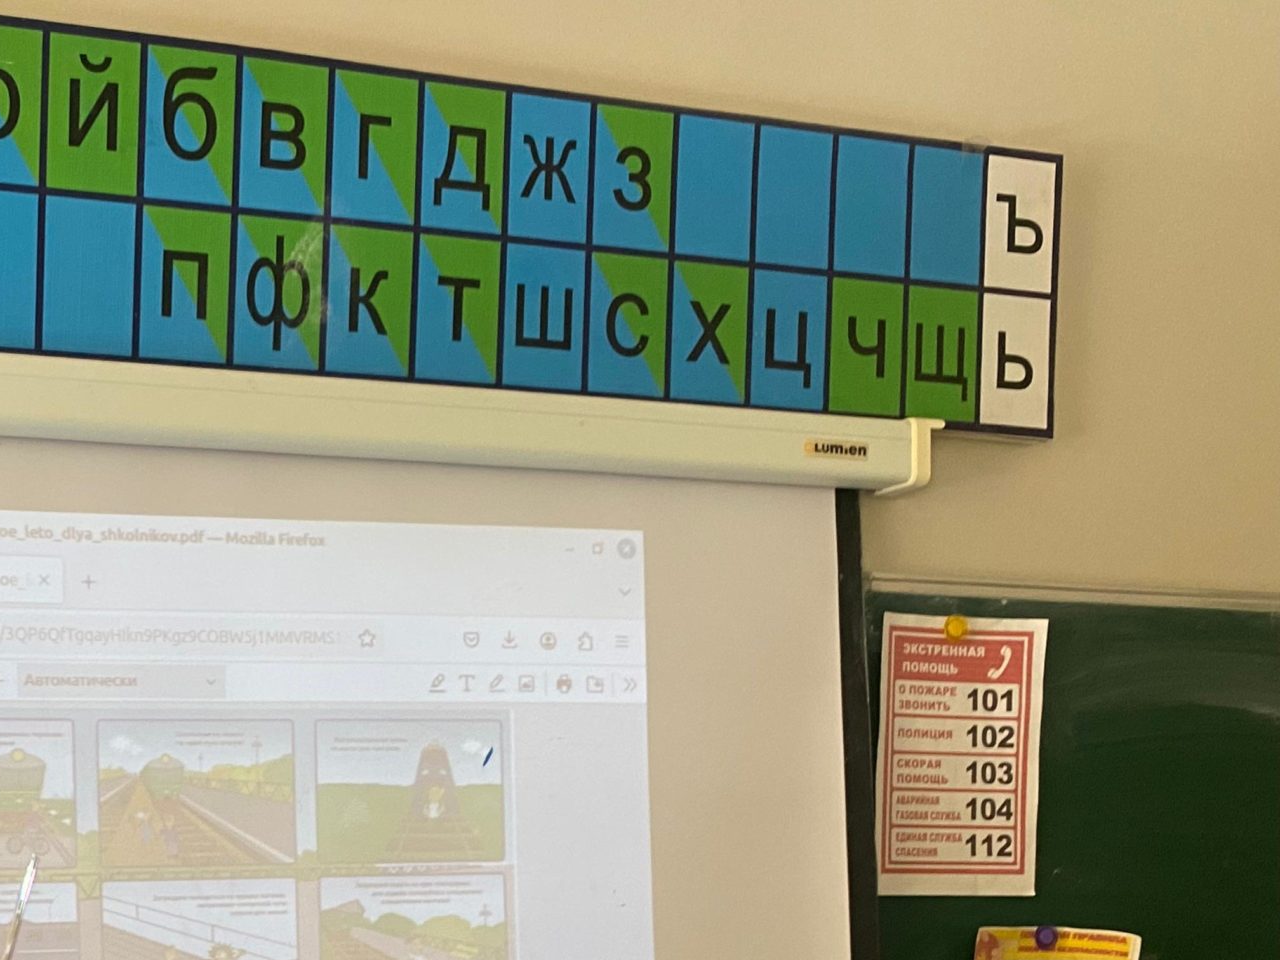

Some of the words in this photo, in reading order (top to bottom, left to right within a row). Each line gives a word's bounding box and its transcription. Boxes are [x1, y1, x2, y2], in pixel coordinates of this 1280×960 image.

[68, 53, 119, 152] й
[162, 66, 218, 162] б
[259, 100, 307, 171] в
[358, 112, 392, 180] г
[433, 124, 491, 212] д
[520, 134, 577, 204] ж
[612, 145, 652, 212] з
[996, 193, 1044, 255] ъ
[161, 249, 209, 321] п
[246, 234, 311, 352] ф
[348, 266, 389, 336] к
[437, 274, 481, 342] т
[514, 283, 574, 351] ш
[605, 292, 650, 358] с
[686, 300, 732, 366] х
[764, 308, 812, 390] ц
[847, 315, 887, 379] ч
[913, 322, 969, 402] щ
[996, 331, 1034, 390] ь
[224, 532, 276, 547] Mozilla
[277, 533, 327, 549] Firefox
[903, 642, 986, 658] ЭКСТРЕННАЯ
[902, 661, 959, 676] ПОМОЩЬ
[24, 672, 138, 689] Автоматически
[899, 684, 907, 695] О
[909, 685, 958, 697] ПОЖАРЕ
[898, 699, 951, 712] ЗВОНИТЬ
[967, 688, 1014, 712] 101
[897, 728, 953, 741] ПОЛИЦИЯ
[966, 724, 1015, 749] 102
[896, 758, 942, 769] СКОРАЯ
[896, 773, 949, 785] ПОМОЩЬ
[966, 760, 1014, 785] 103
[965, 797, 1013, 821] 104
[965, 833, 1012, 857] 112
